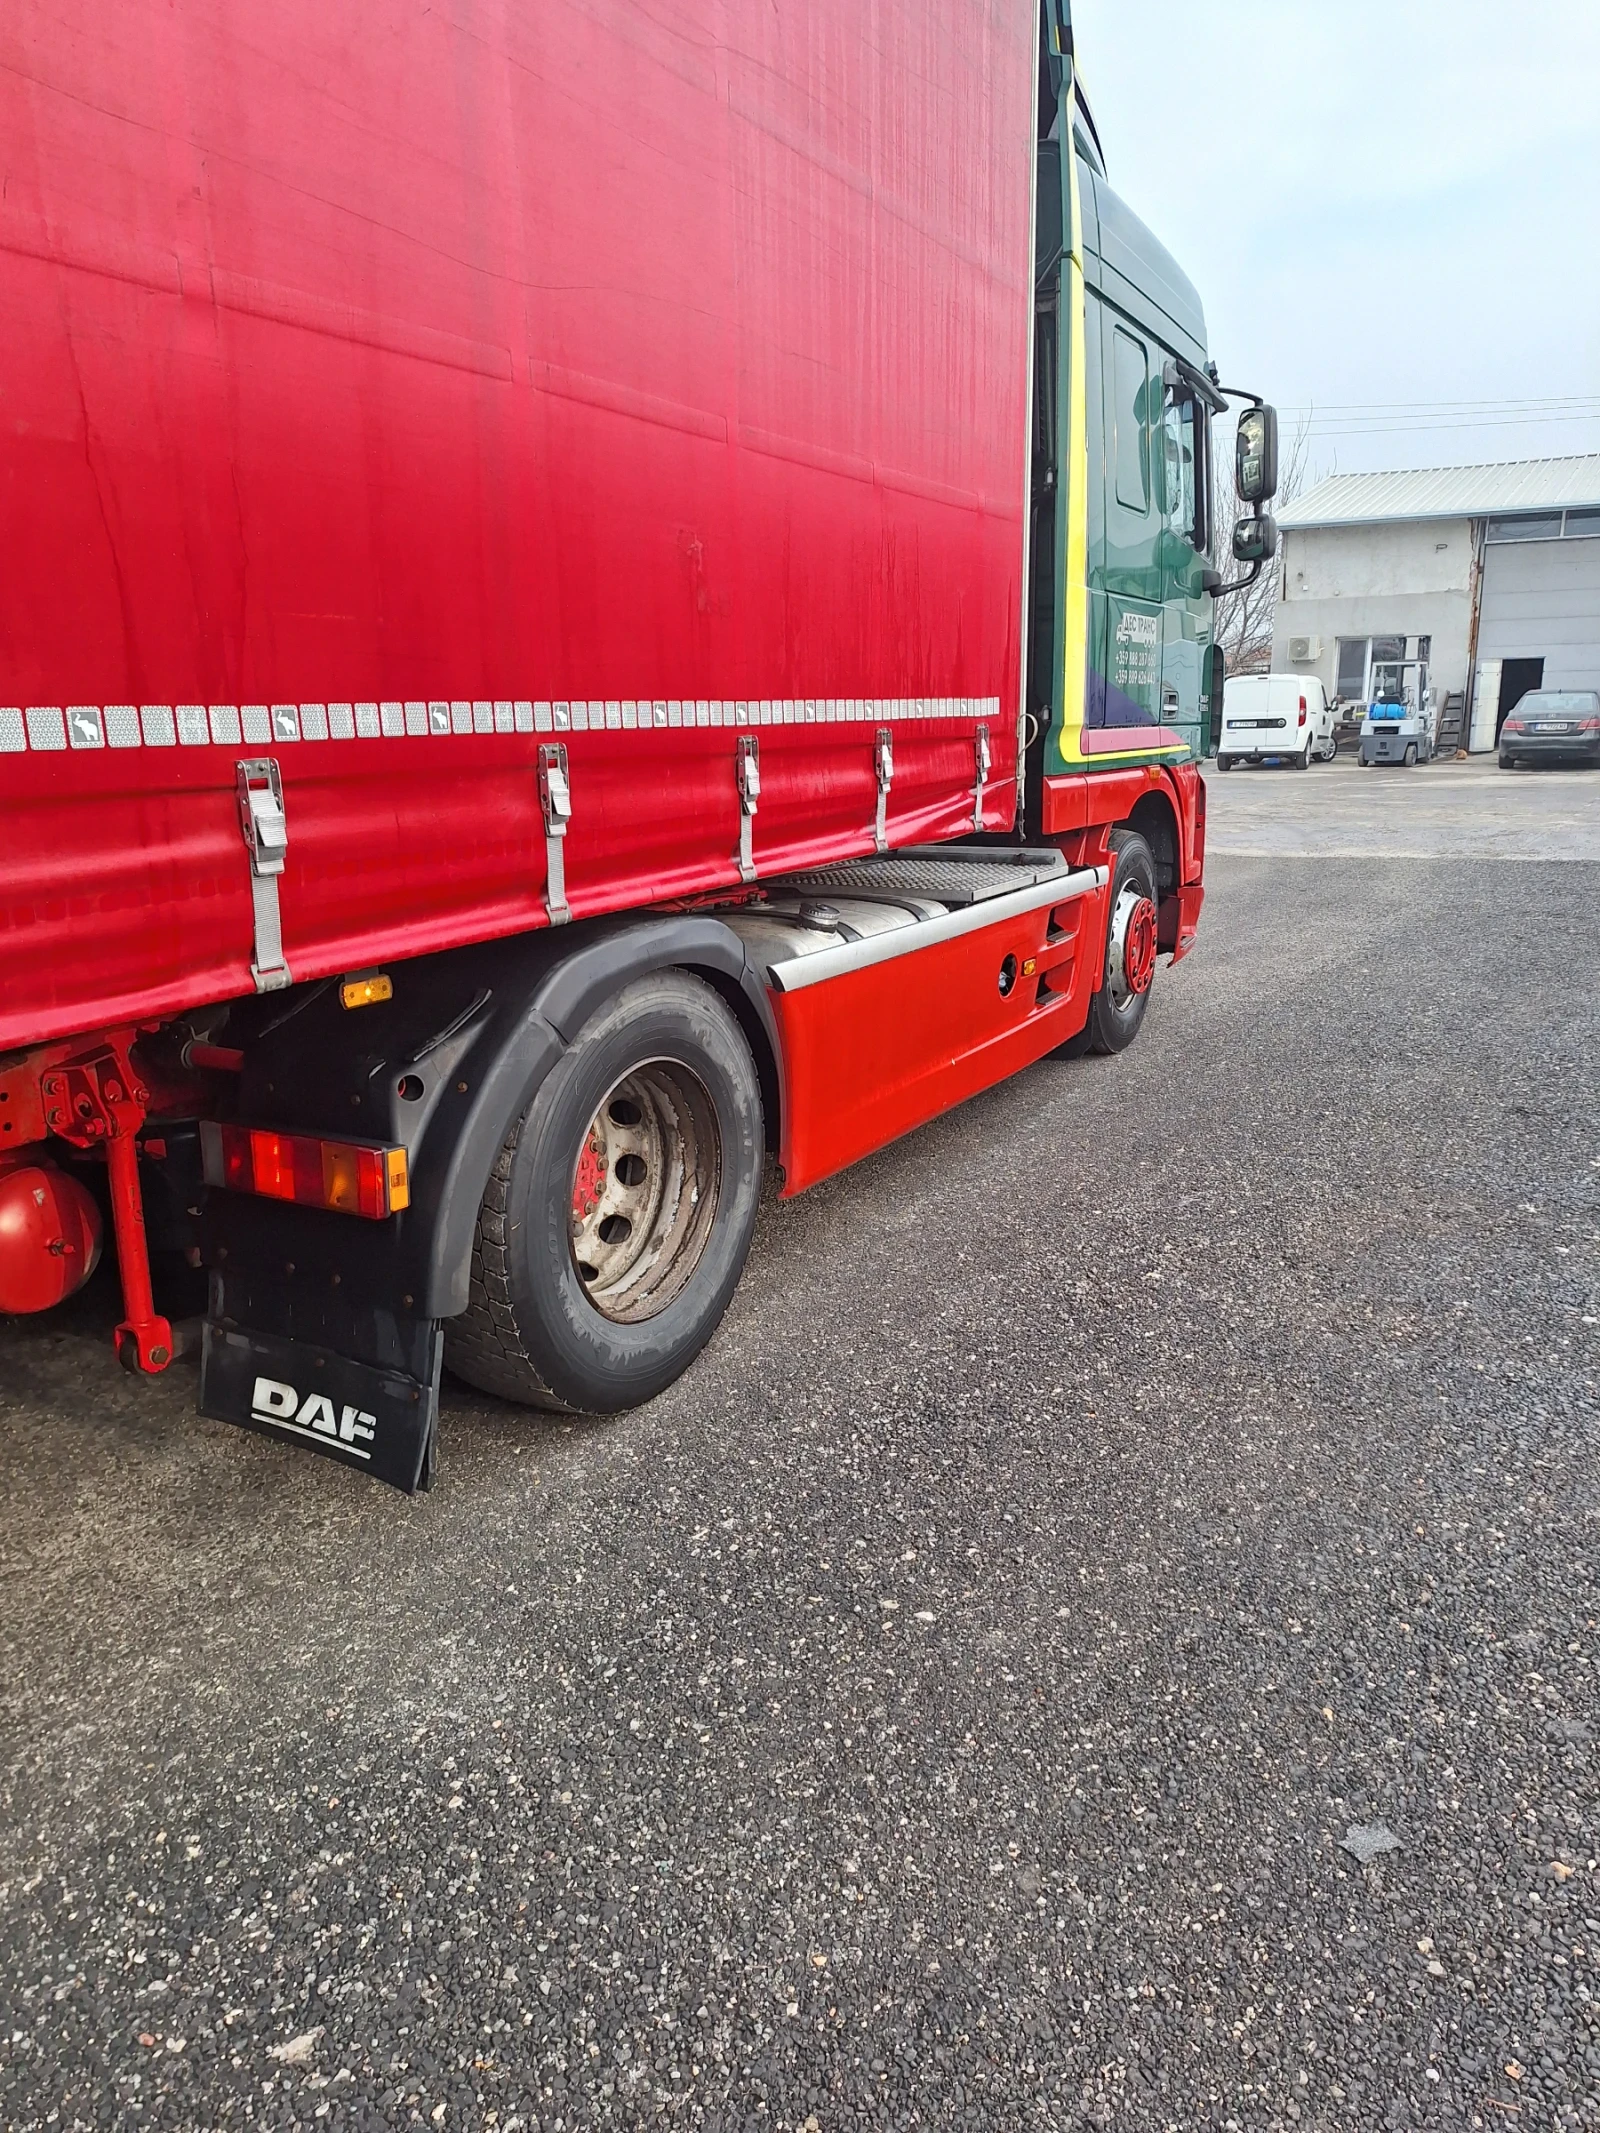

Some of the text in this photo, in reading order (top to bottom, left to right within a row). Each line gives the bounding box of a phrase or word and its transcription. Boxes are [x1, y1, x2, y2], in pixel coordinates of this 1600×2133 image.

[1115, 650, 1128, 665] +359
[1115, 669, 1128, 684] +359
[251, 1376, 377, 1442] DAF
